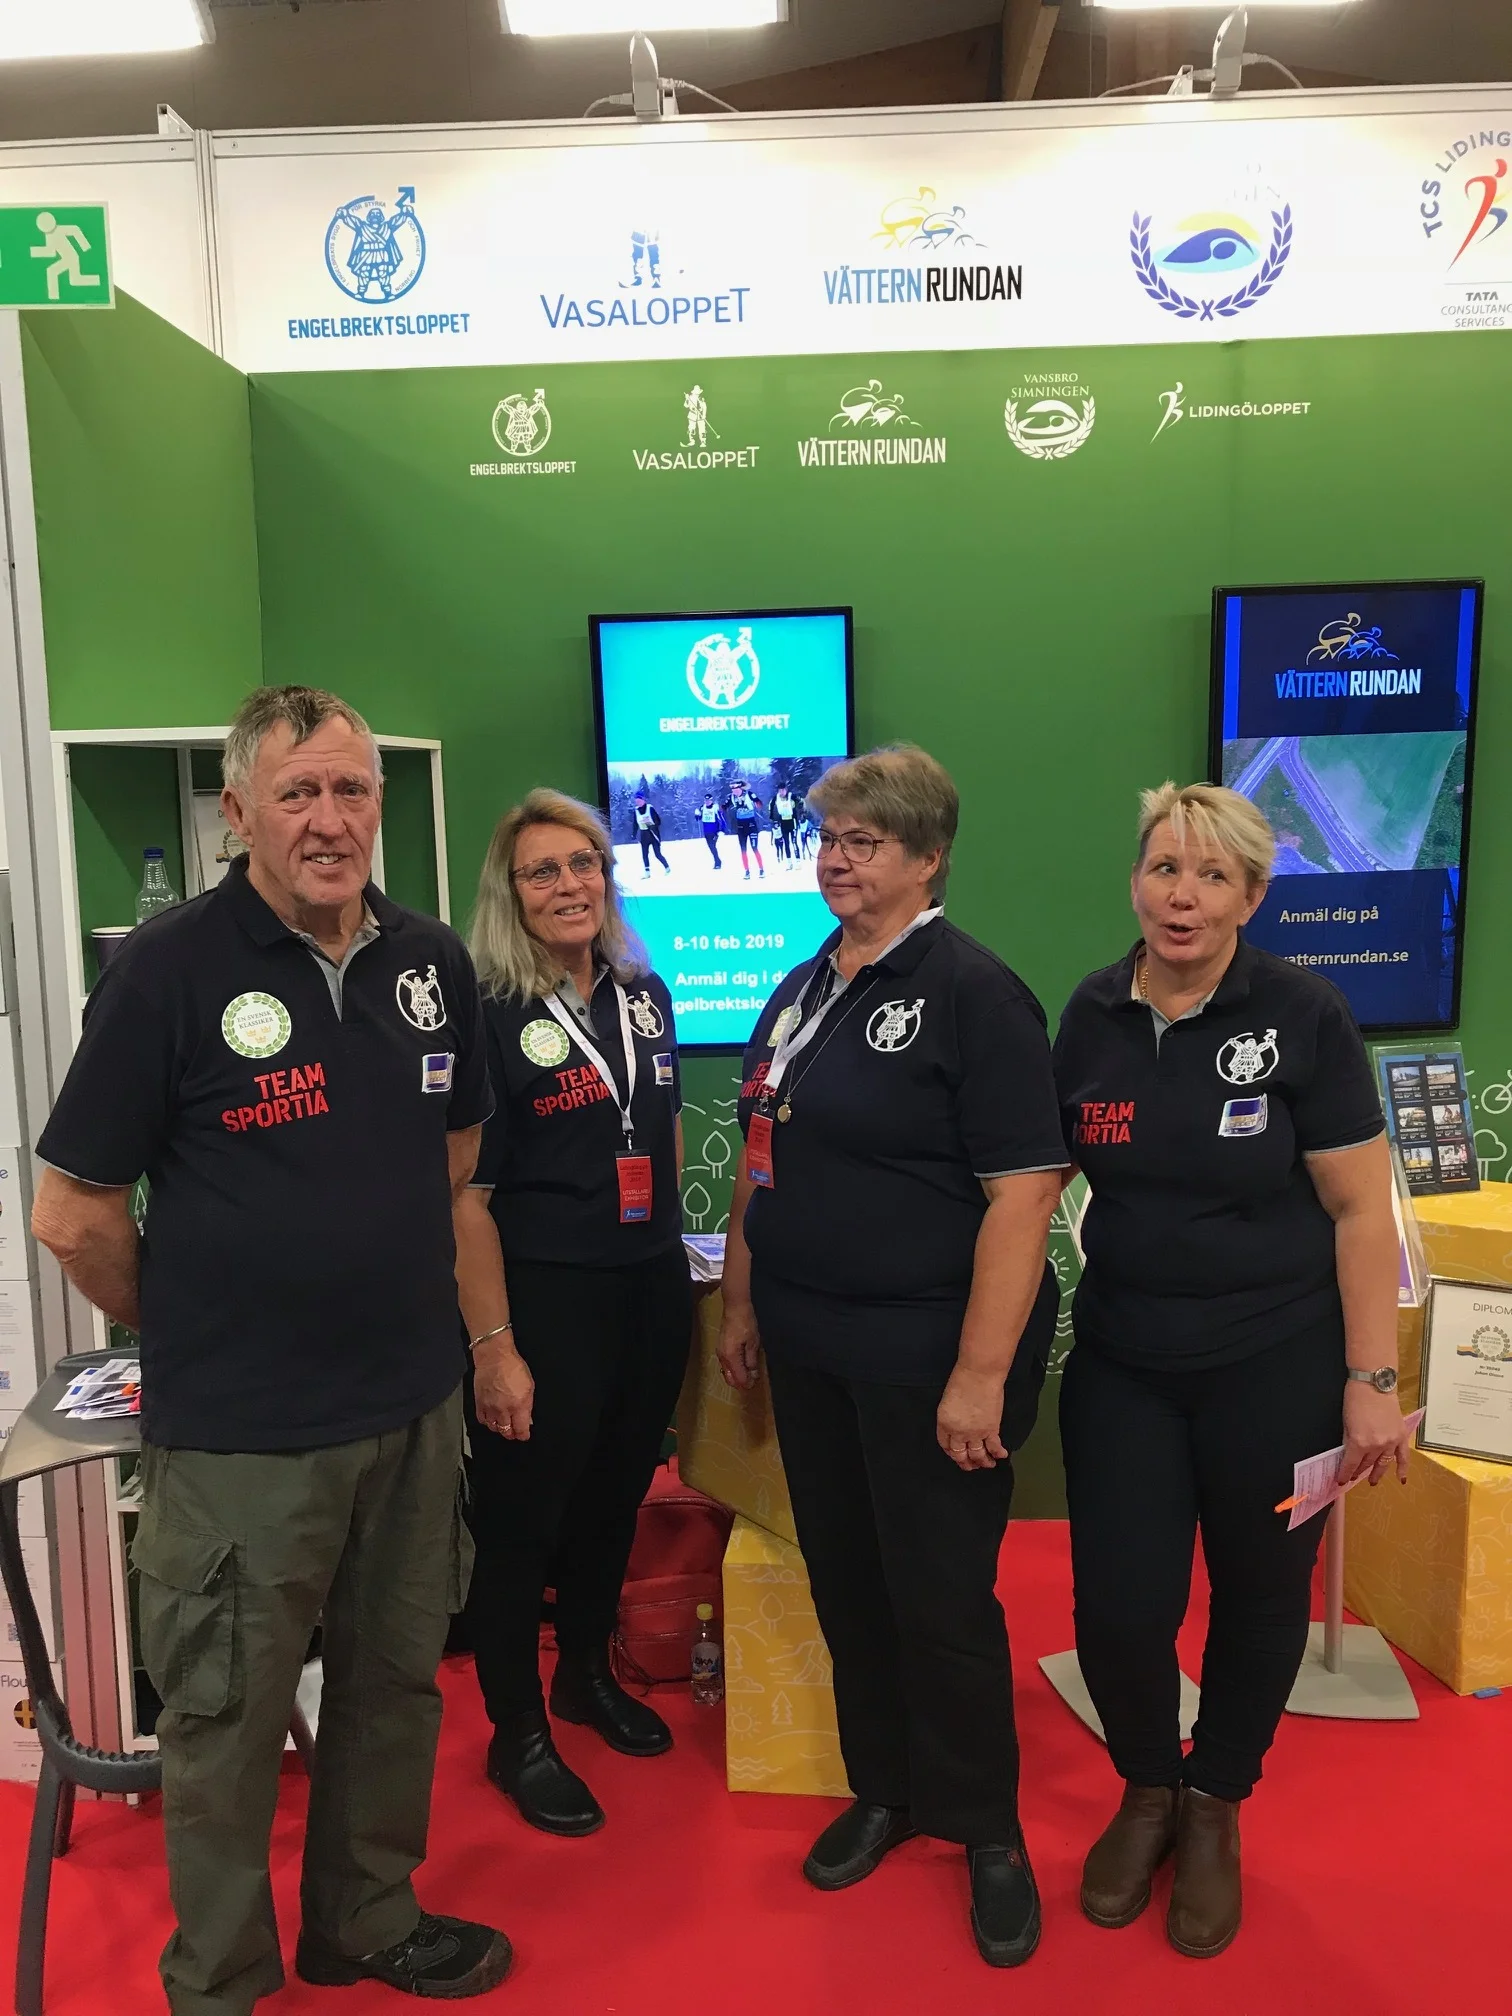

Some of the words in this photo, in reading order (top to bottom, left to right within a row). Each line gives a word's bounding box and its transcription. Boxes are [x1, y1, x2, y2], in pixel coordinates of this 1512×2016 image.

[1420, 179, 1443, 238] TCS
[1465, 291, 1499, 301] TATA
[540, 287, 750, 329] VASALOPPET
[288, 313, 470, 339] ENGELBREKTSLOPPET
[1454, 316, 1505, 328] SERVICES
[1023, 372, 1079, 384] VANSBRO
[1010, 385, 1090, 399] SIMNINGEN
[1189, 401, 1312, 418] LIDINGÖLOPPET
[632, 445, 760, 470] VASALOPPET
[470, 460, 577, 476] ENGELBREKTSLOPPET
[659, 713, 790, 733] ENGELBREKTSLOPPET
[1279, 907, 1329, 923] Anmäl
[1332, 907, 1357, 924] dig
[1360, 905, 1379, 924] på
[673, 935, 709, 951] 8-10
[713, 935, 741, 950] feb
[745, 933, 785, 949] 2019
[1284, 949, 1409, 966] atternrundan.se
[675, 970, 728, 987] Anmäl
[731, 970, 759, 989] dig
[672, 995, 770, 1015] gelbrektslo
[238, 1016, 275, 1030] KLASSIKER
[254, 1062, 328, 1100] TEAM
[533, 1081, 611, 1117] SPORTIA
[221, 1089, 331, 1133] SPORTIA
[1081, 1101, 1135, 1123] TEAM
[1073, 1121, 1132, 1144] ORTIA
[1472, 1302, 1512, 1316] DIPLOM
